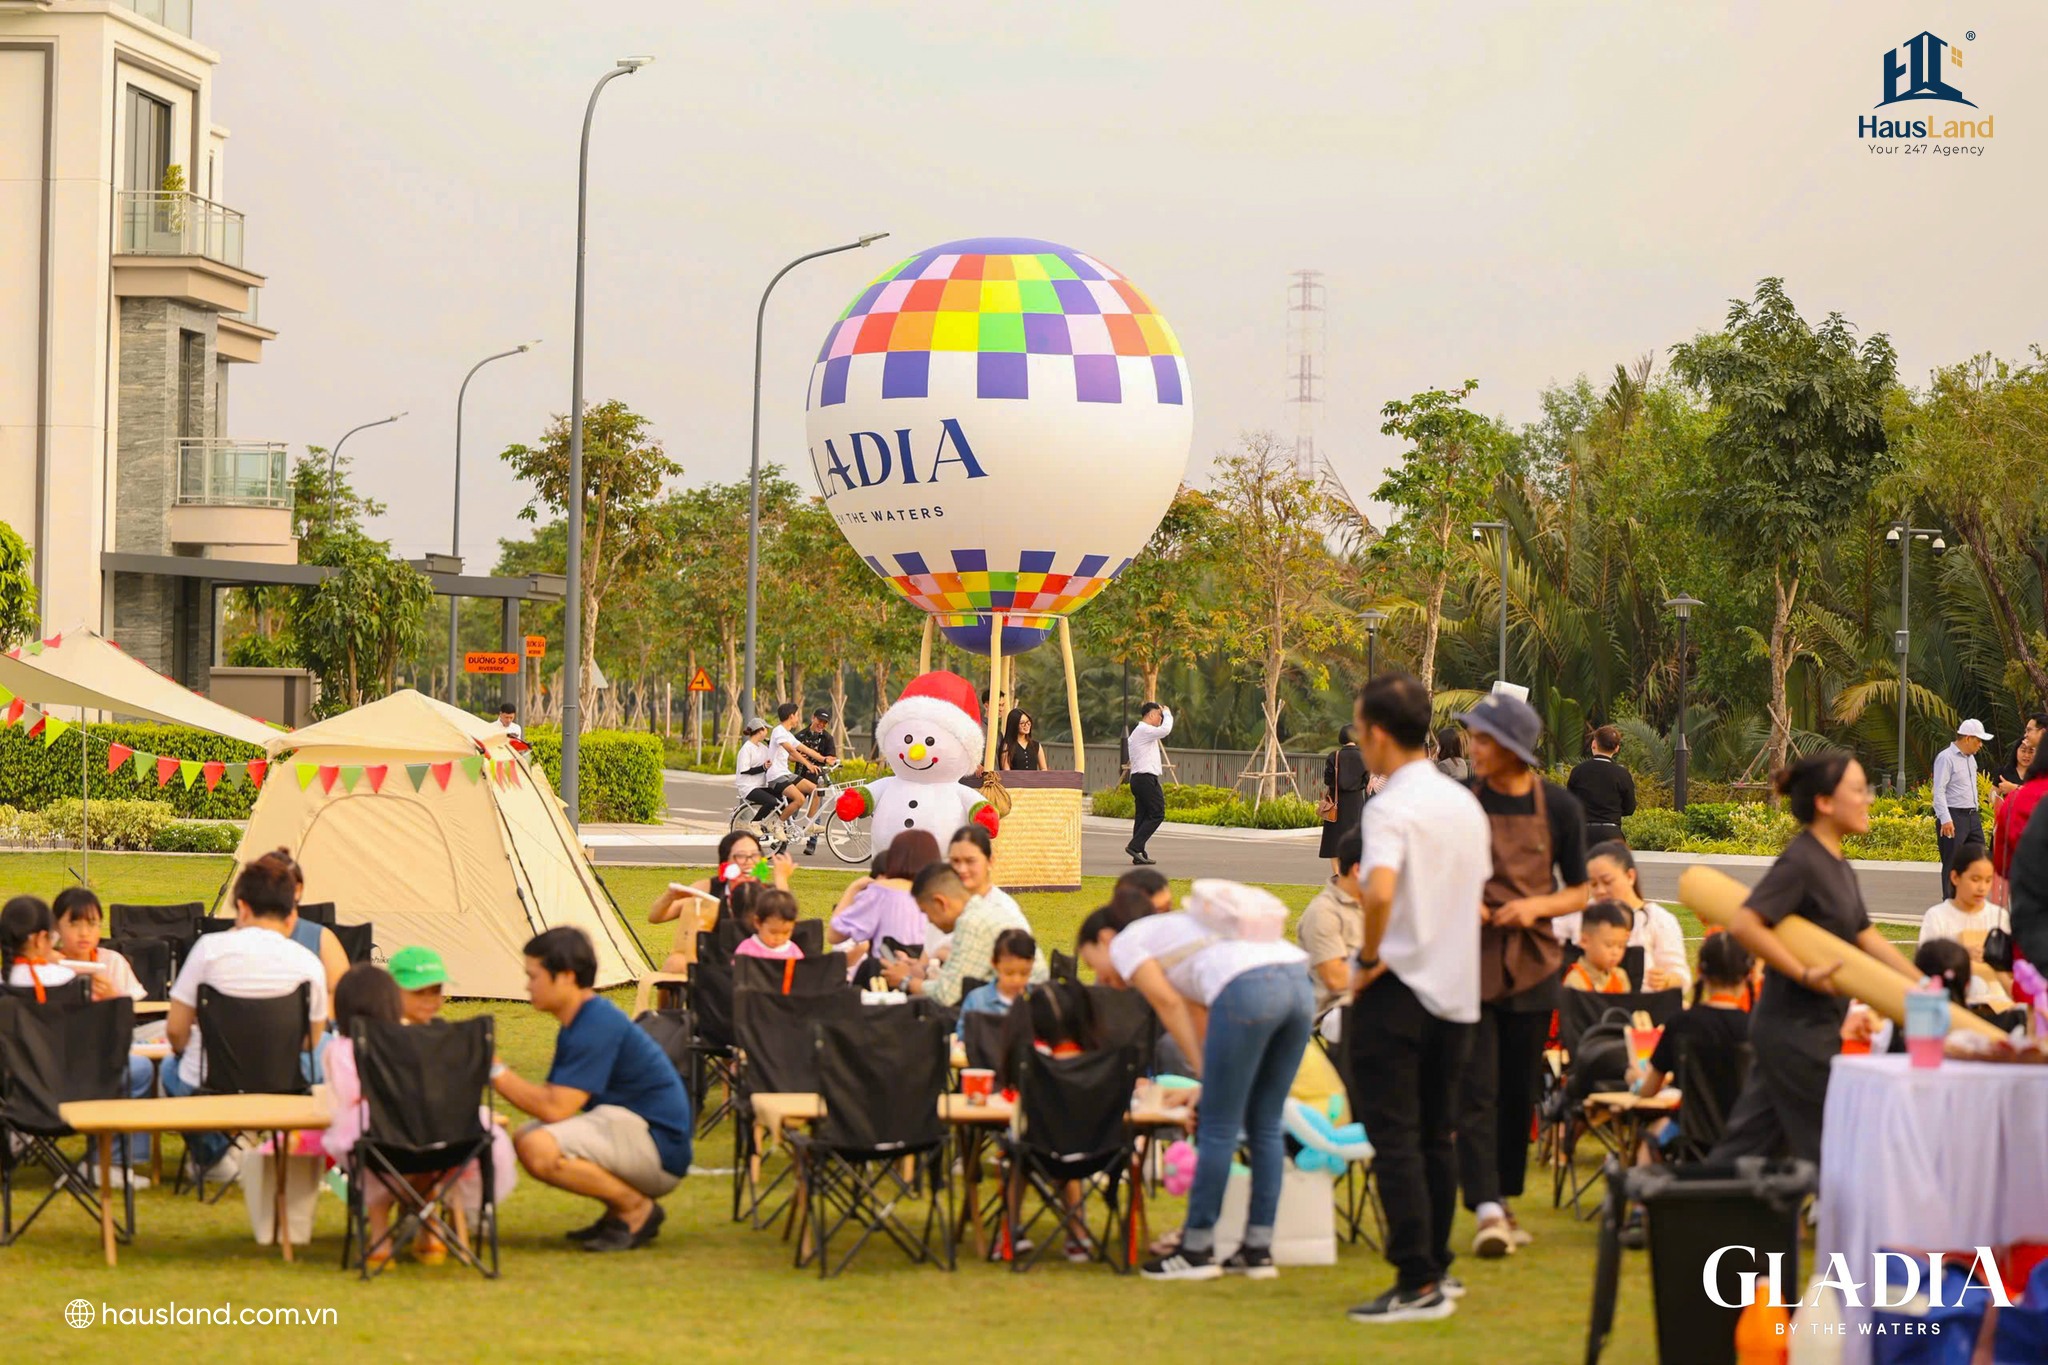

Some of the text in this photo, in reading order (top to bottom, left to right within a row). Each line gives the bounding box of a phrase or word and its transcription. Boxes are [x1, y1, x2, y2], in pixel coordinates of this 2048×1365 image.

[809, 417, 990, 500] LADIA
[846, 512, 868, 524] THE
[870, 506, 944, 522] WATERS
[511, 657, 516, 665] 3
